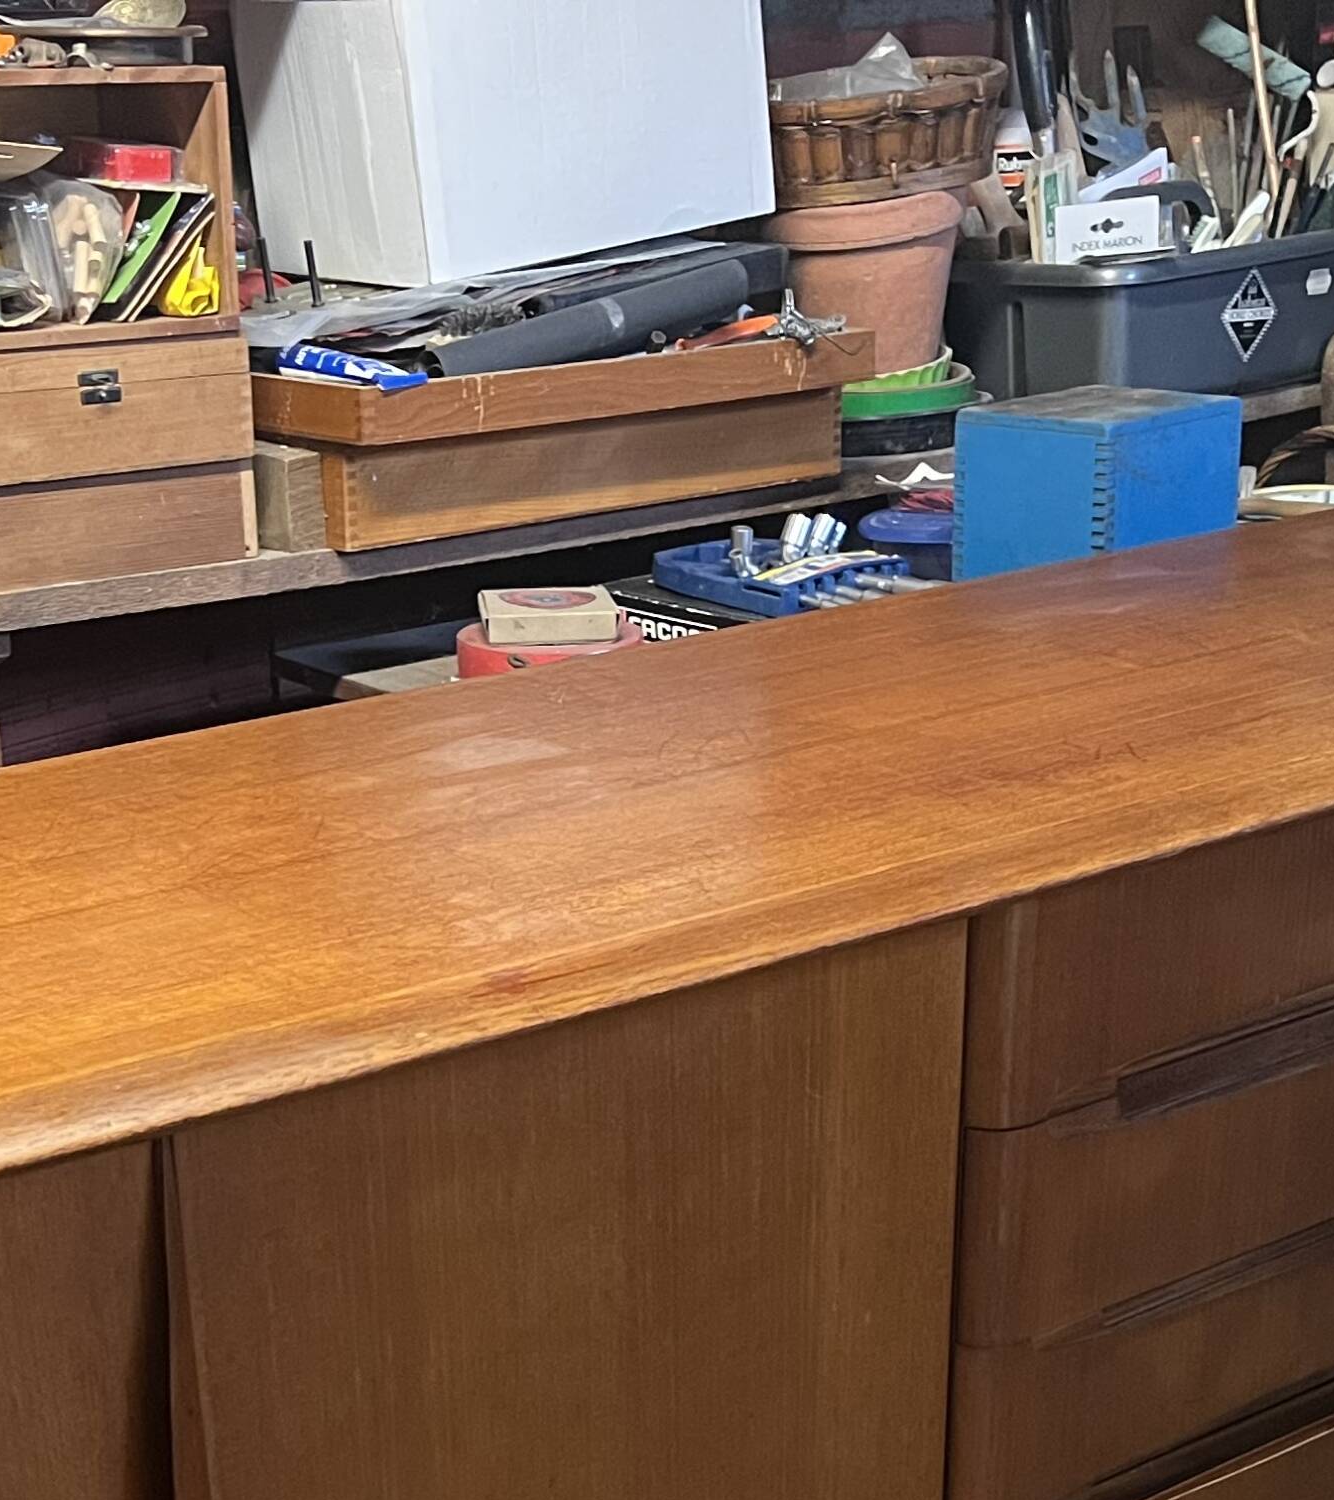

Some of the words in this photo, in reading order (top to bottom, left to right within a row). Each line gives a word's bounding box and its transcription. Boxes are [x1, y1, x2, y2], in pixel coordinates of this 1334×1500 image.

[1072, 240, 1101, 252] INDEX
[1103, 235, 1143, 250] MARION
[628, 615, 700, 641] ACO
